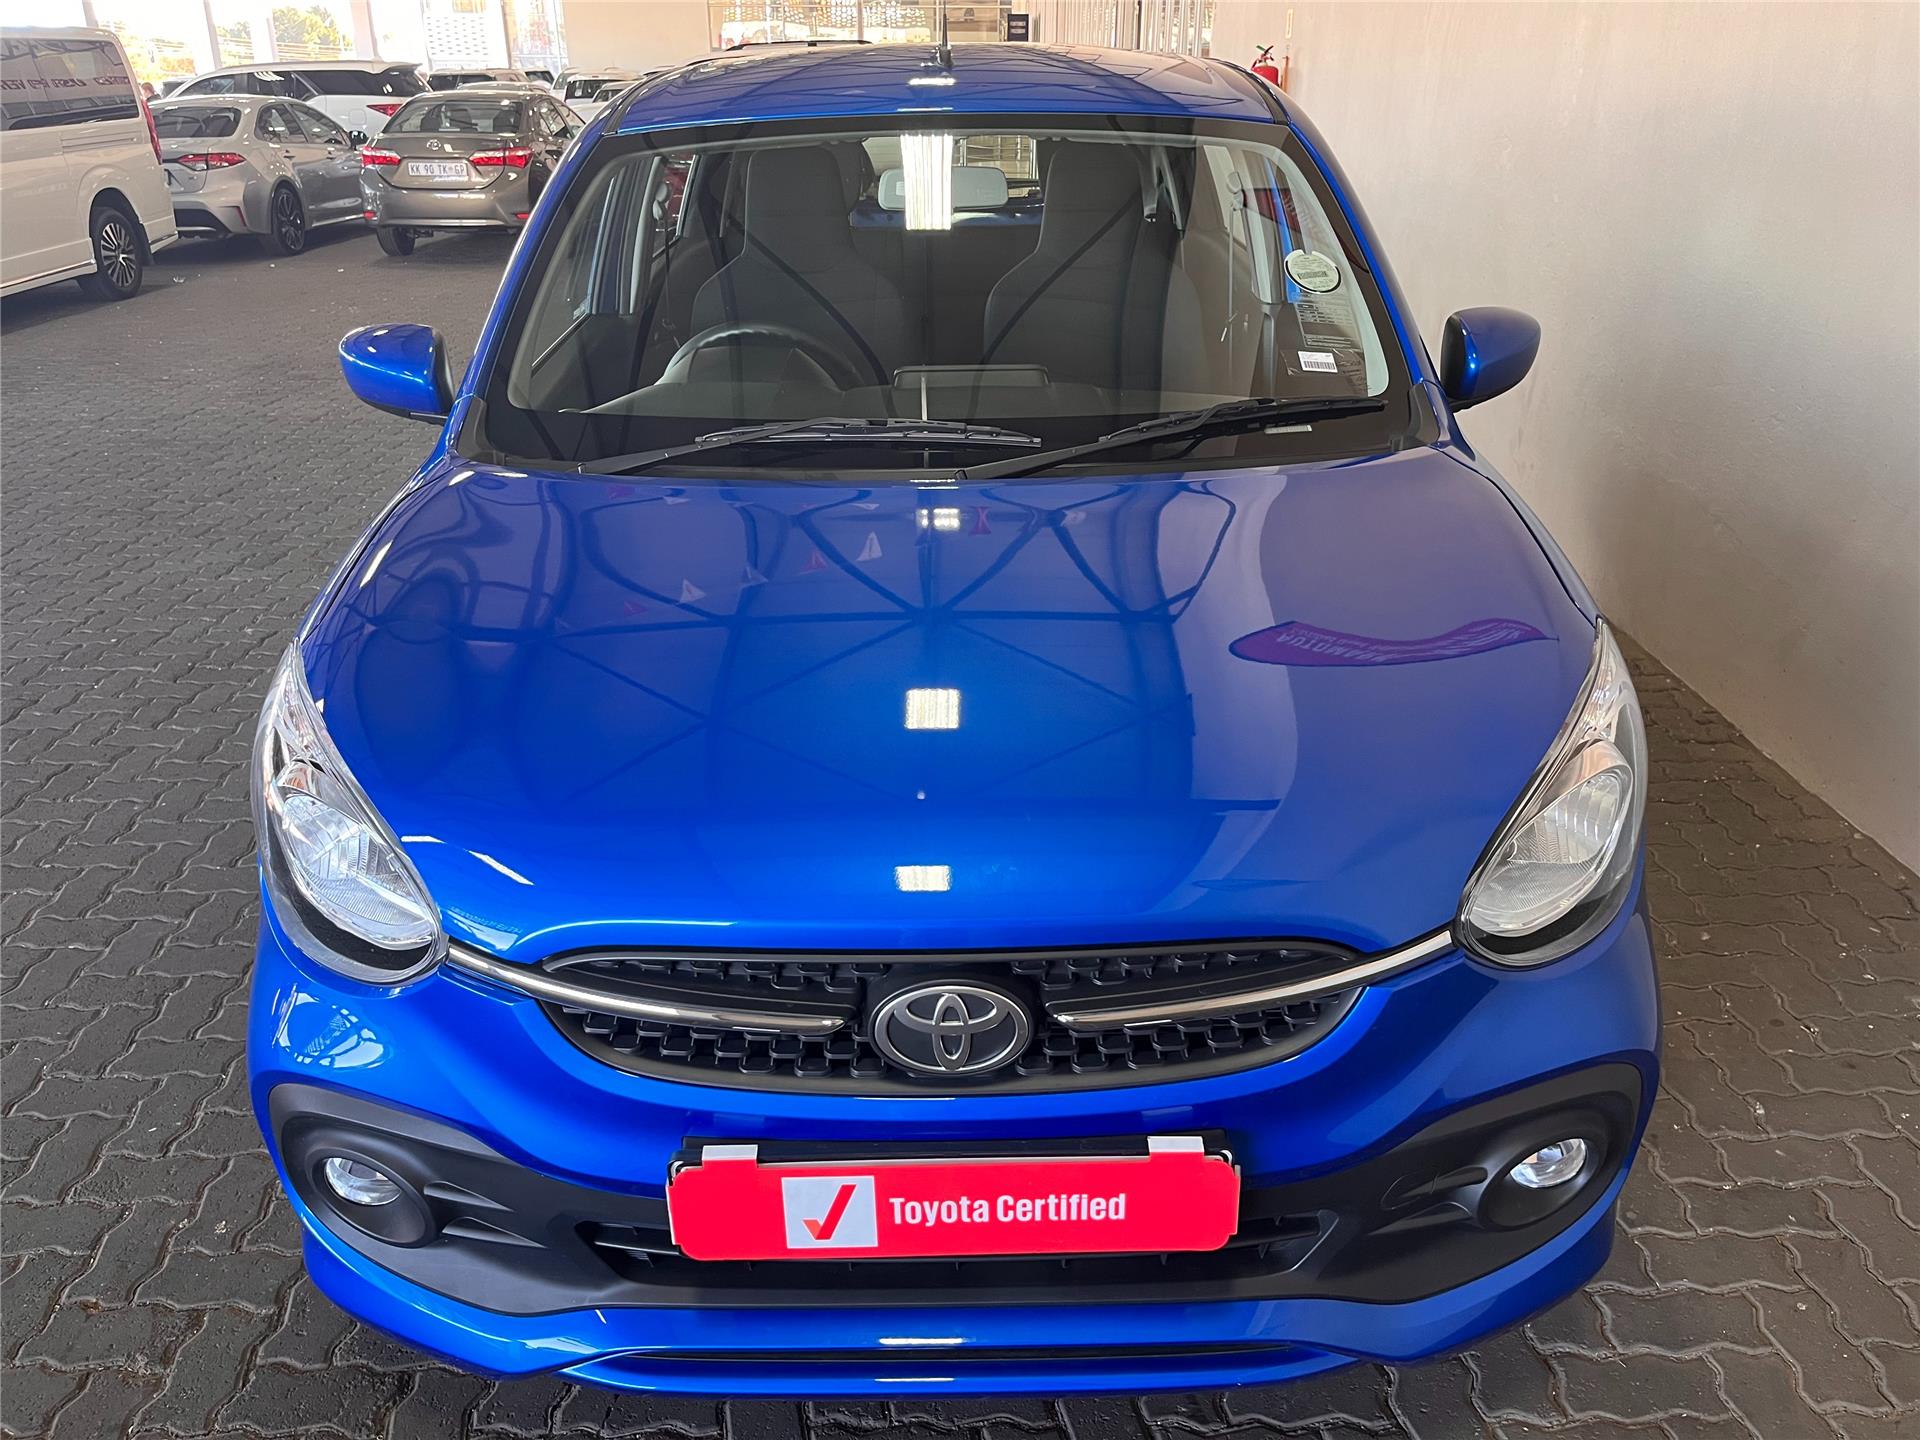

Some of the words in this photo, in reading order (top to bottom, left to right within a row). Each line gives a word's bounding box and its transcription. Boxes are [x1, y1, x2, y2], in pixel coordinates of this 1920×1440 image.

[410, 164, 421, 174] KK
[424, 164, 435, 174] 90
[438, 164, 449, 174] TK
[454, 164, 465, 174] GP
[889, 1196, 990, 1227] Toyota
[996, 1193, 1126, 1222] Certified
